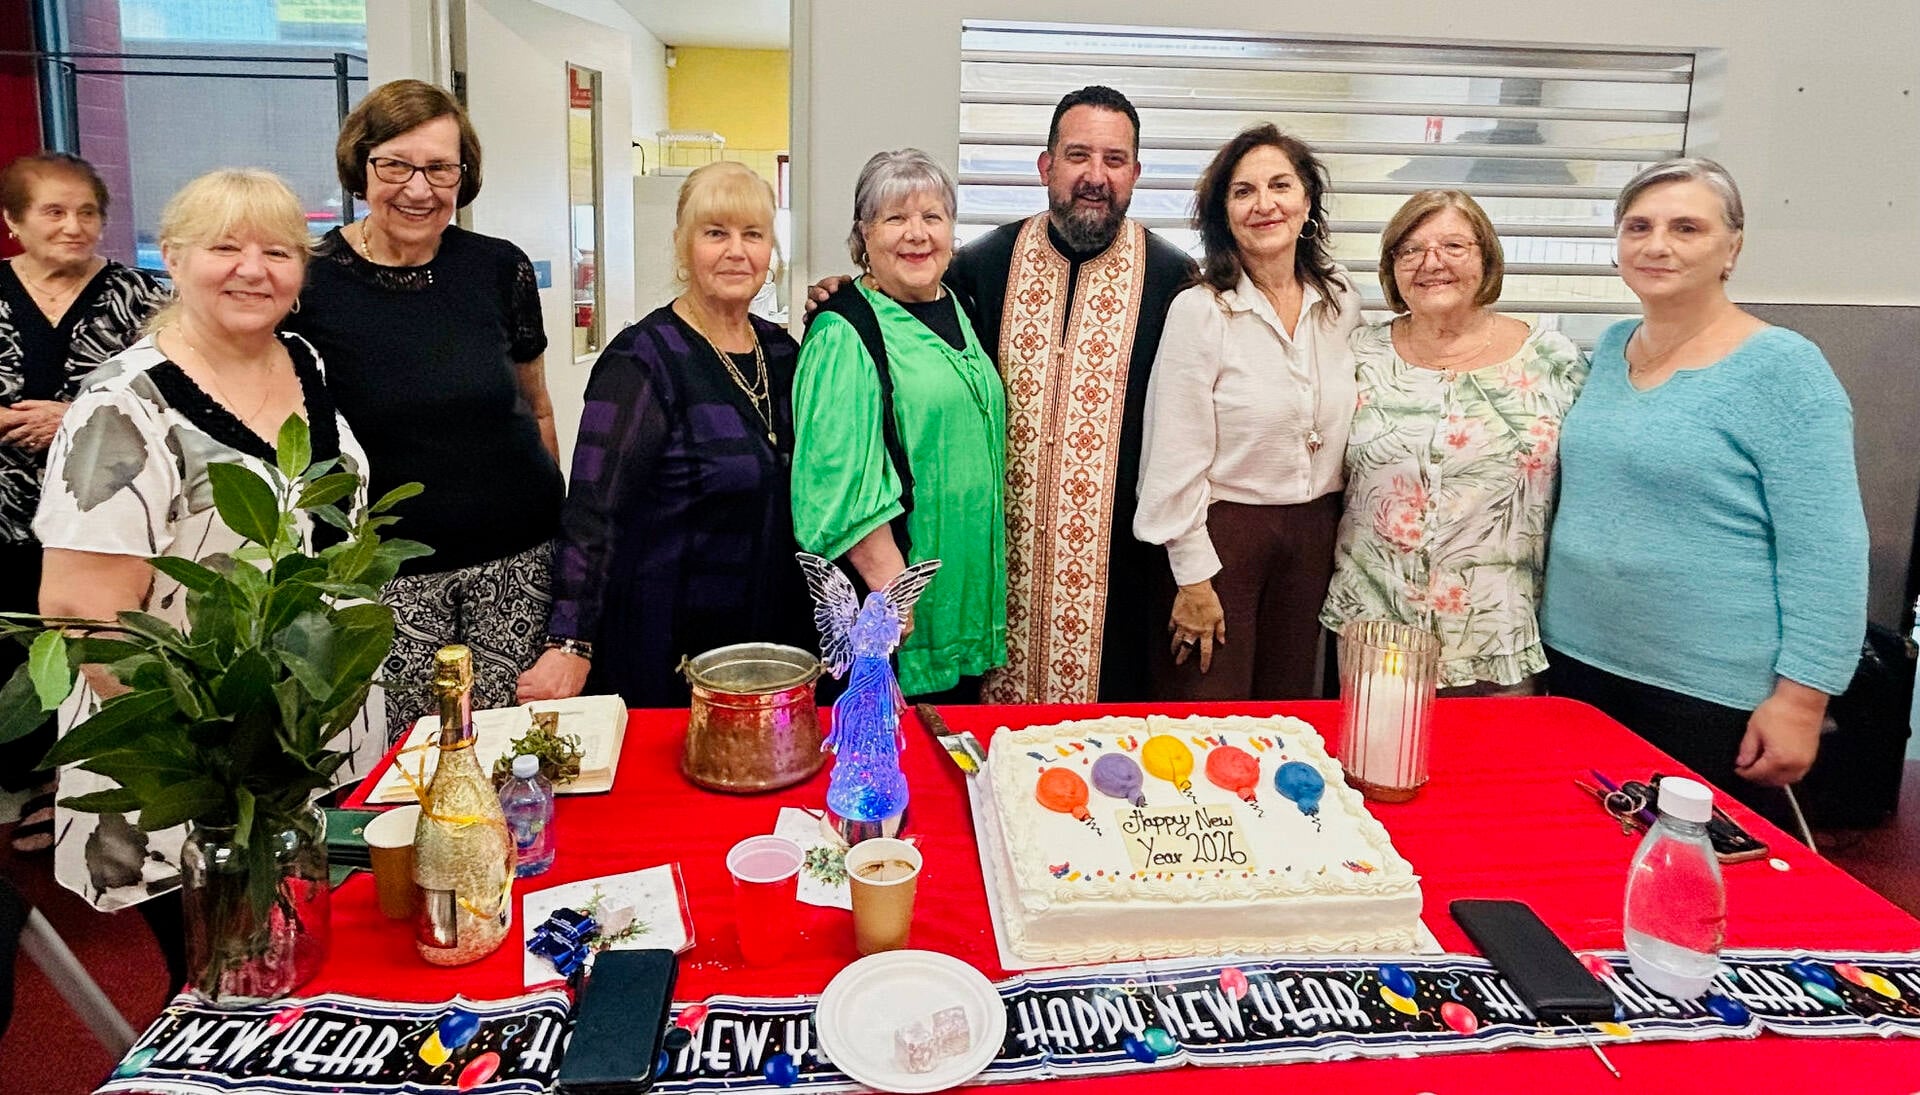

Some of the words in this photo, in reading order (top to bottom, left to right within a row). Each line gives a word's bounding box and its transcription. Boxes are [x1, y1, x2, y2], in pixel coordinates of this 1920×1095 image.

[1122, 809, 1190, 837] Happy
[1195, 807, 1233, 831] New
[1136, 837, 1183, 869] Year
[1185, 830, 1247, 865] 2026
[1016, 994, 1147, 1048] HAPPY
[1152, 987, 1246, 1039] NEW
[1250, 976, 1372, 1032] YEAR
[153, 1017, 282, 1069] NEW
[266, 1017, 399, 1076] YEAR
[675, 1019, 772, 1073] NEW
